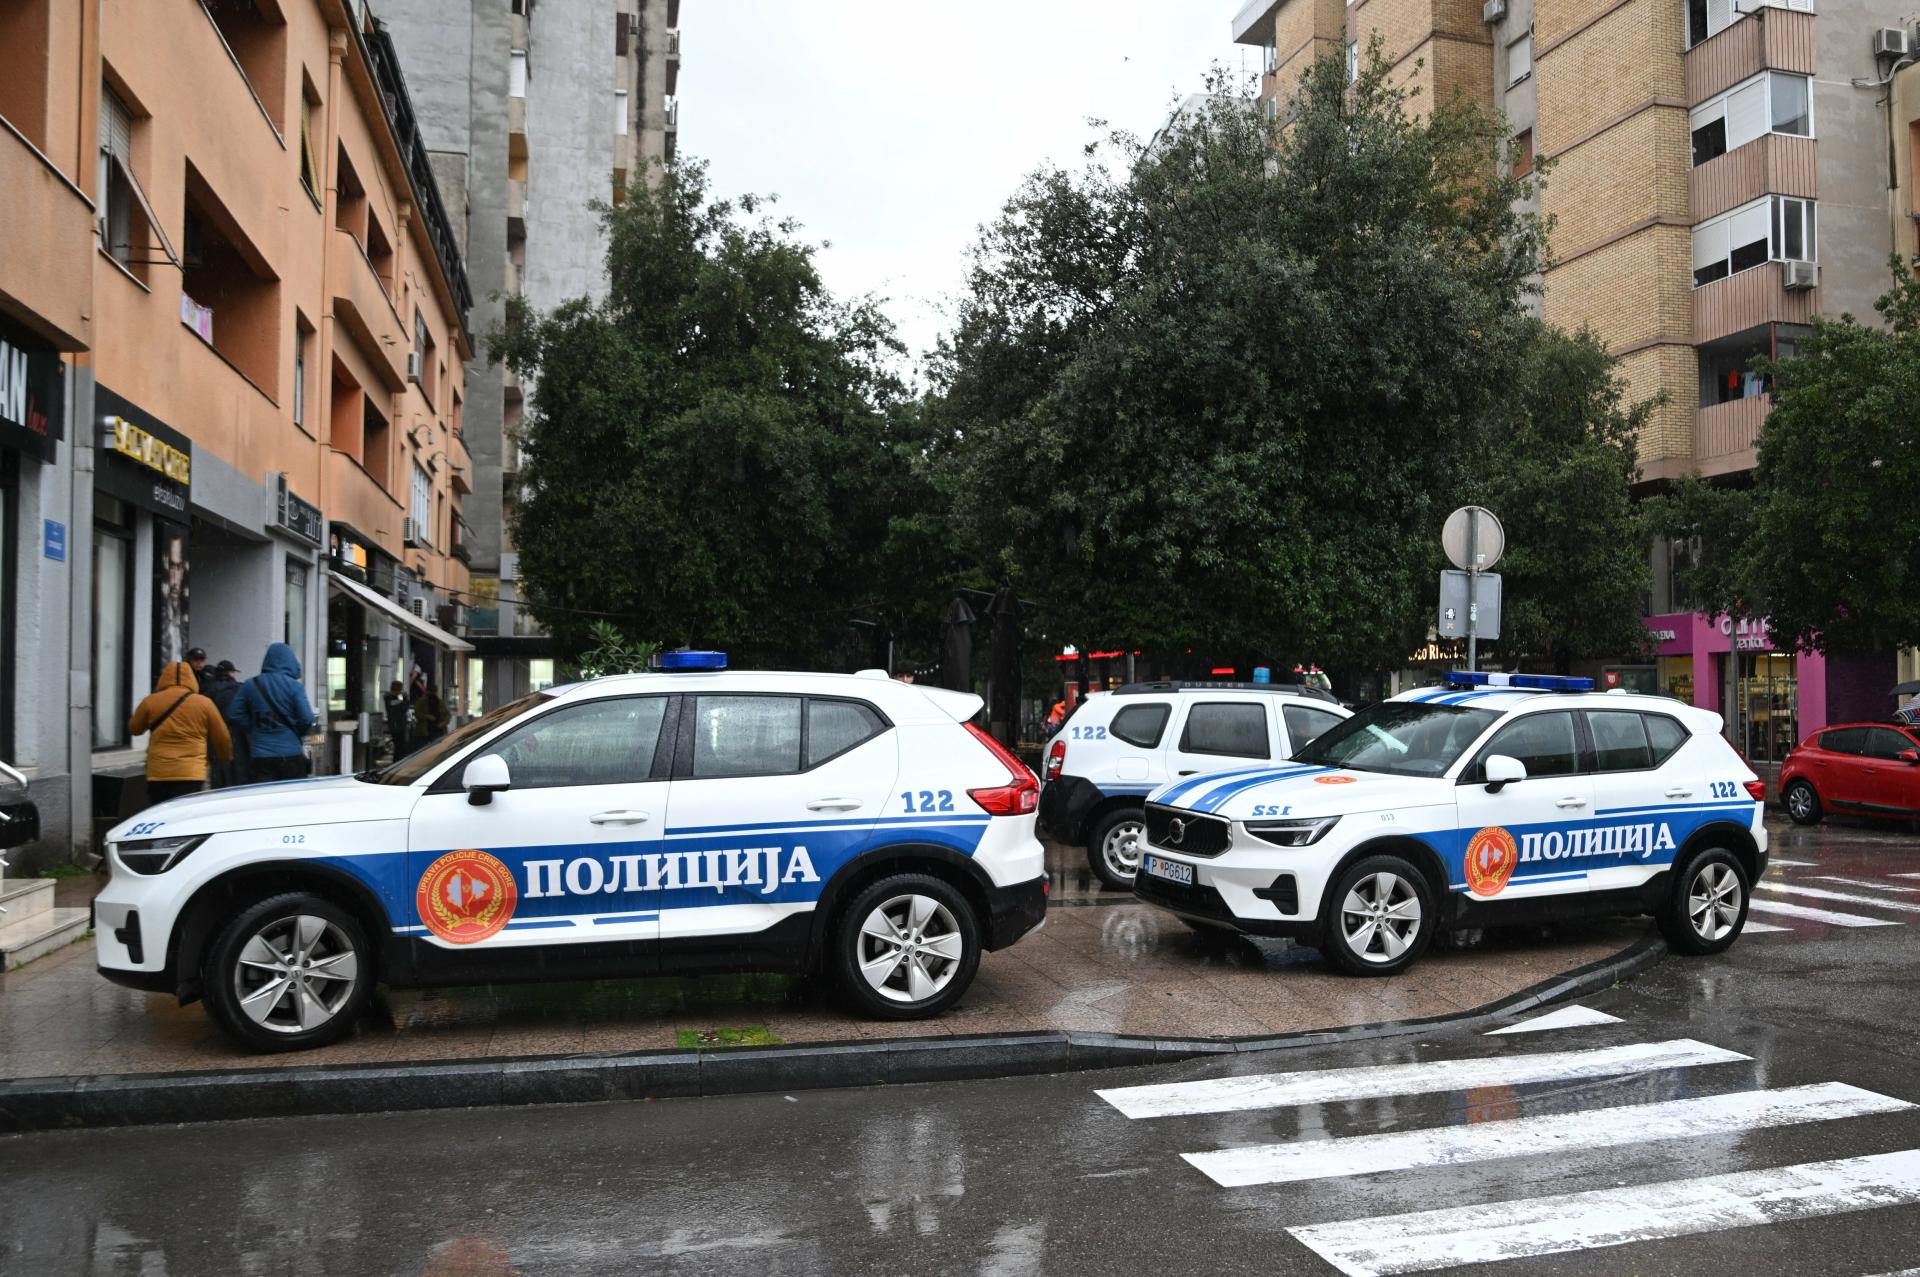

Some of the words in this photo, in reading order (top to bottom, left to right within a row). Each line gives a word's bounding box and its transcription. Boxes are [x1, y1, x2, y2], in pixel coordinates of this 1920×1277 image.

[1072, 726, 1107, 740] 122
[1709, 781, 1738, 798] 122
[900, 789, 955, 813] 122
[282, 834, 305, 844] 012
[1519, 822, 1676, 862] ПОЛИЦИЈА
[419, 864, 442, 894] UPRAVA
[440, 851, 477, 866] POLICIJE
[478, 853, 500, 868] CRNE
[498, 866, 514, 888] GORE
[522, 845, 821, 898] ПОЛИЦИЈА
[1163, 861, 1191, 882] PG612
